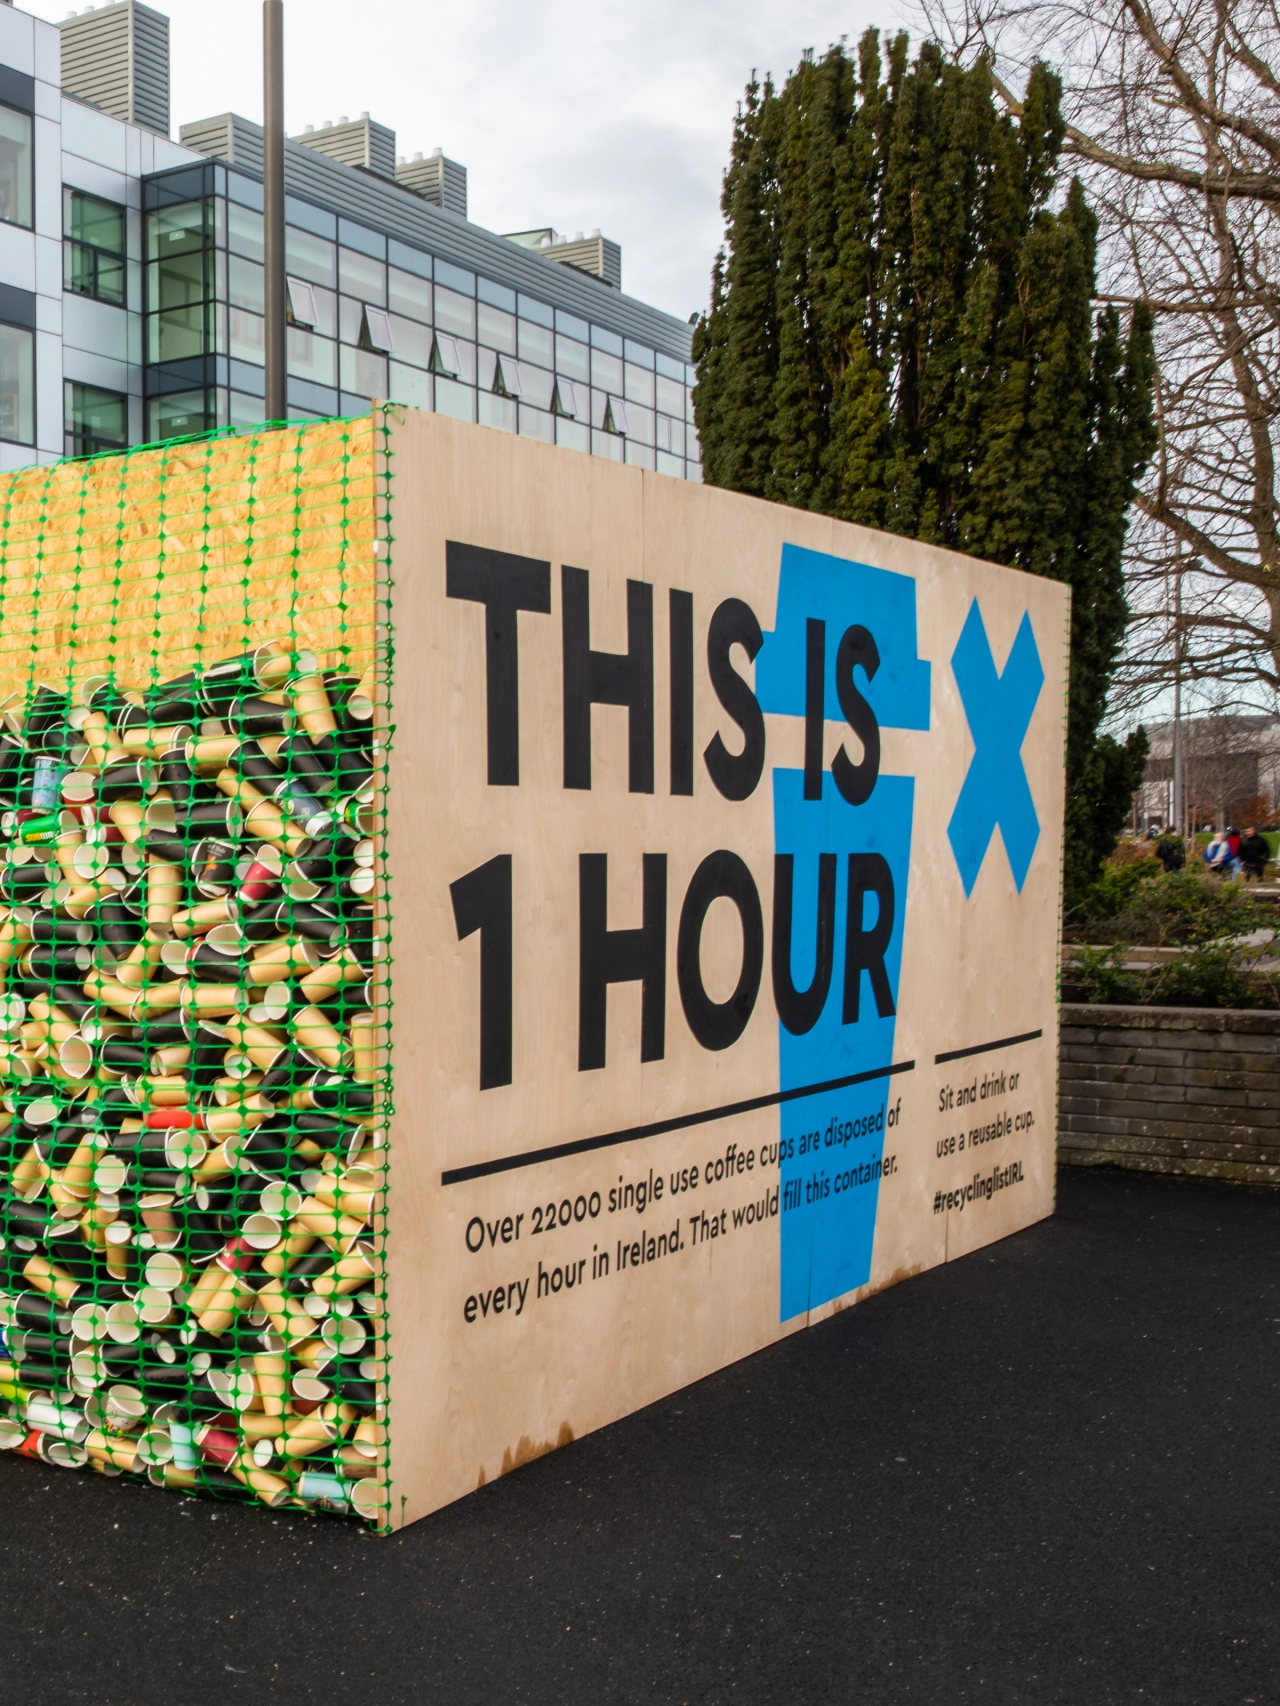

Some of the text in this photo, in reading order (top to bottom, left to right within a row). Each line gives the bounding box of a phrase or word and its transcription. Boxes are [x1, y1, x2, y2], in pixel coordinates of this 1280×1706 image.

[445, 539, 881, 807] THIS IS
[449, 849, 897, 1092] 1 HOUR
[936, 1110, 1035, 1159] use a reusable cup.
[938, 1069, 1020, 1113] Sit and drink or
[463, 1153, 898, 1324] every hour in Ireland. That would fill this container.
[465, 1097, 902, 1253] Over 22000 single use coffee cups are disposed of
[933, 1160, 1025, 1216] #recyclinglistIRL
